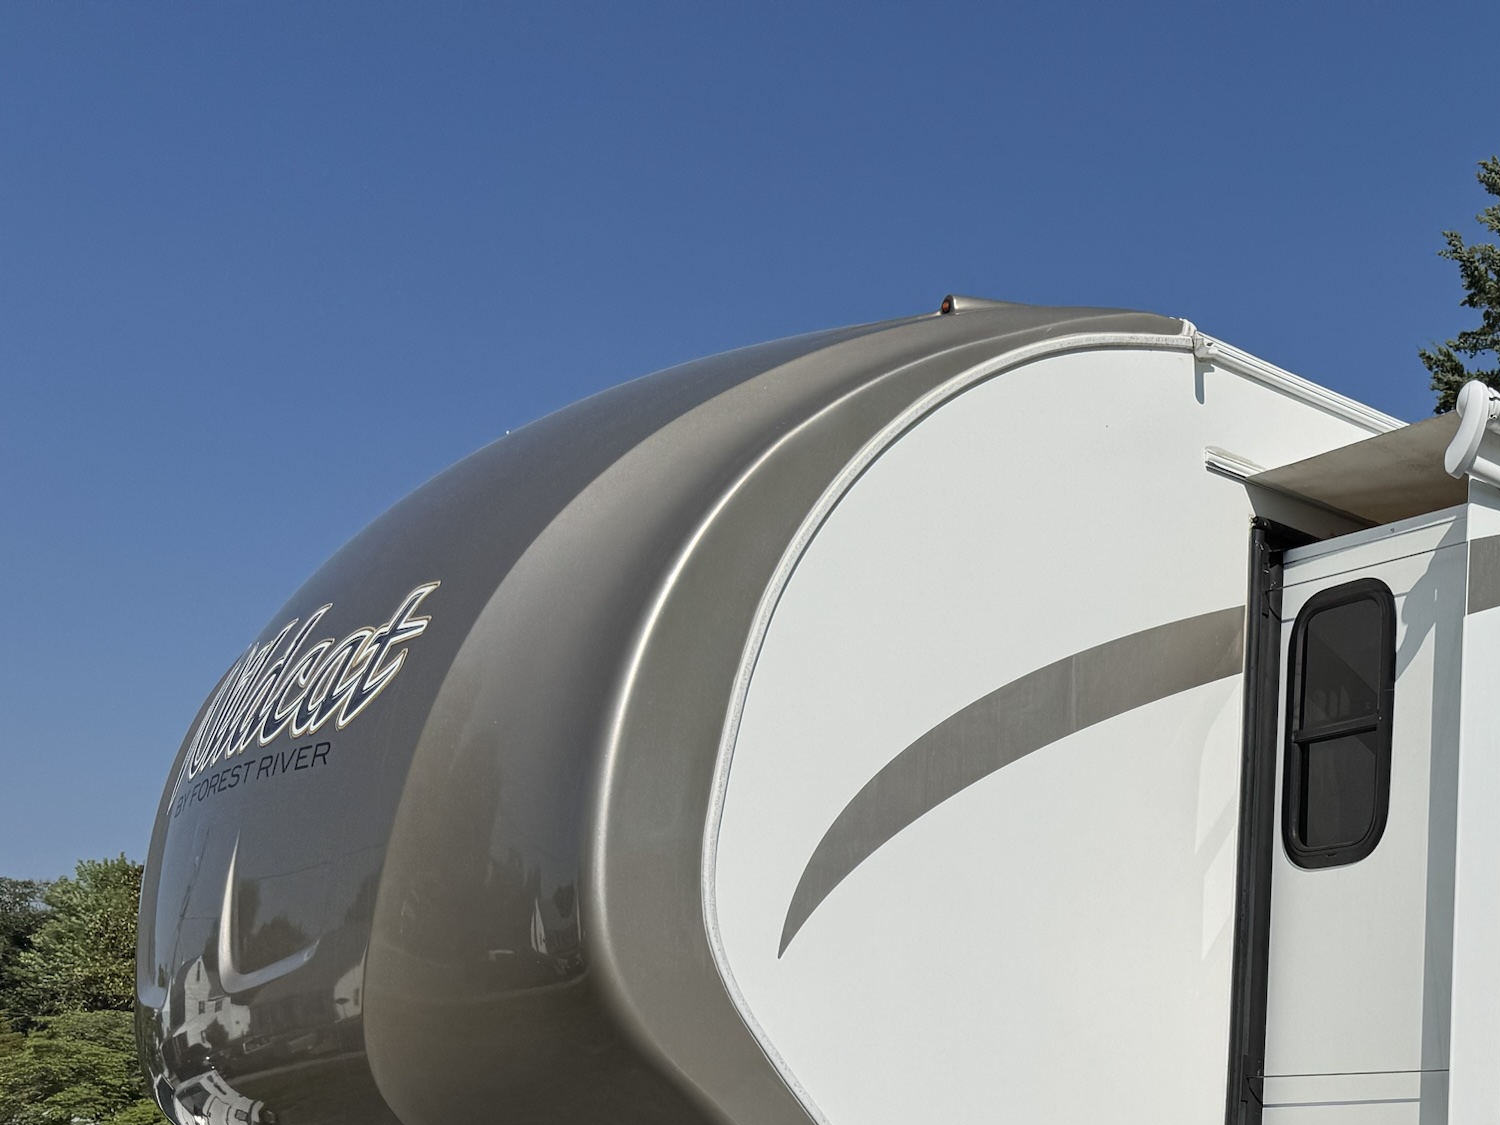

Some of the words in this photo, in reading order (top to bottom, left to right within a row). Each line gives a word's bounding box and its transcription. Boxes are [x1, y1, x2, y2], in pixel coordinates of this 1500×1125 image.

[174, 788, 192, 818] BY
[190, 761, 256, 807] FOREST
[256, 741, 331, 780] RIVER
